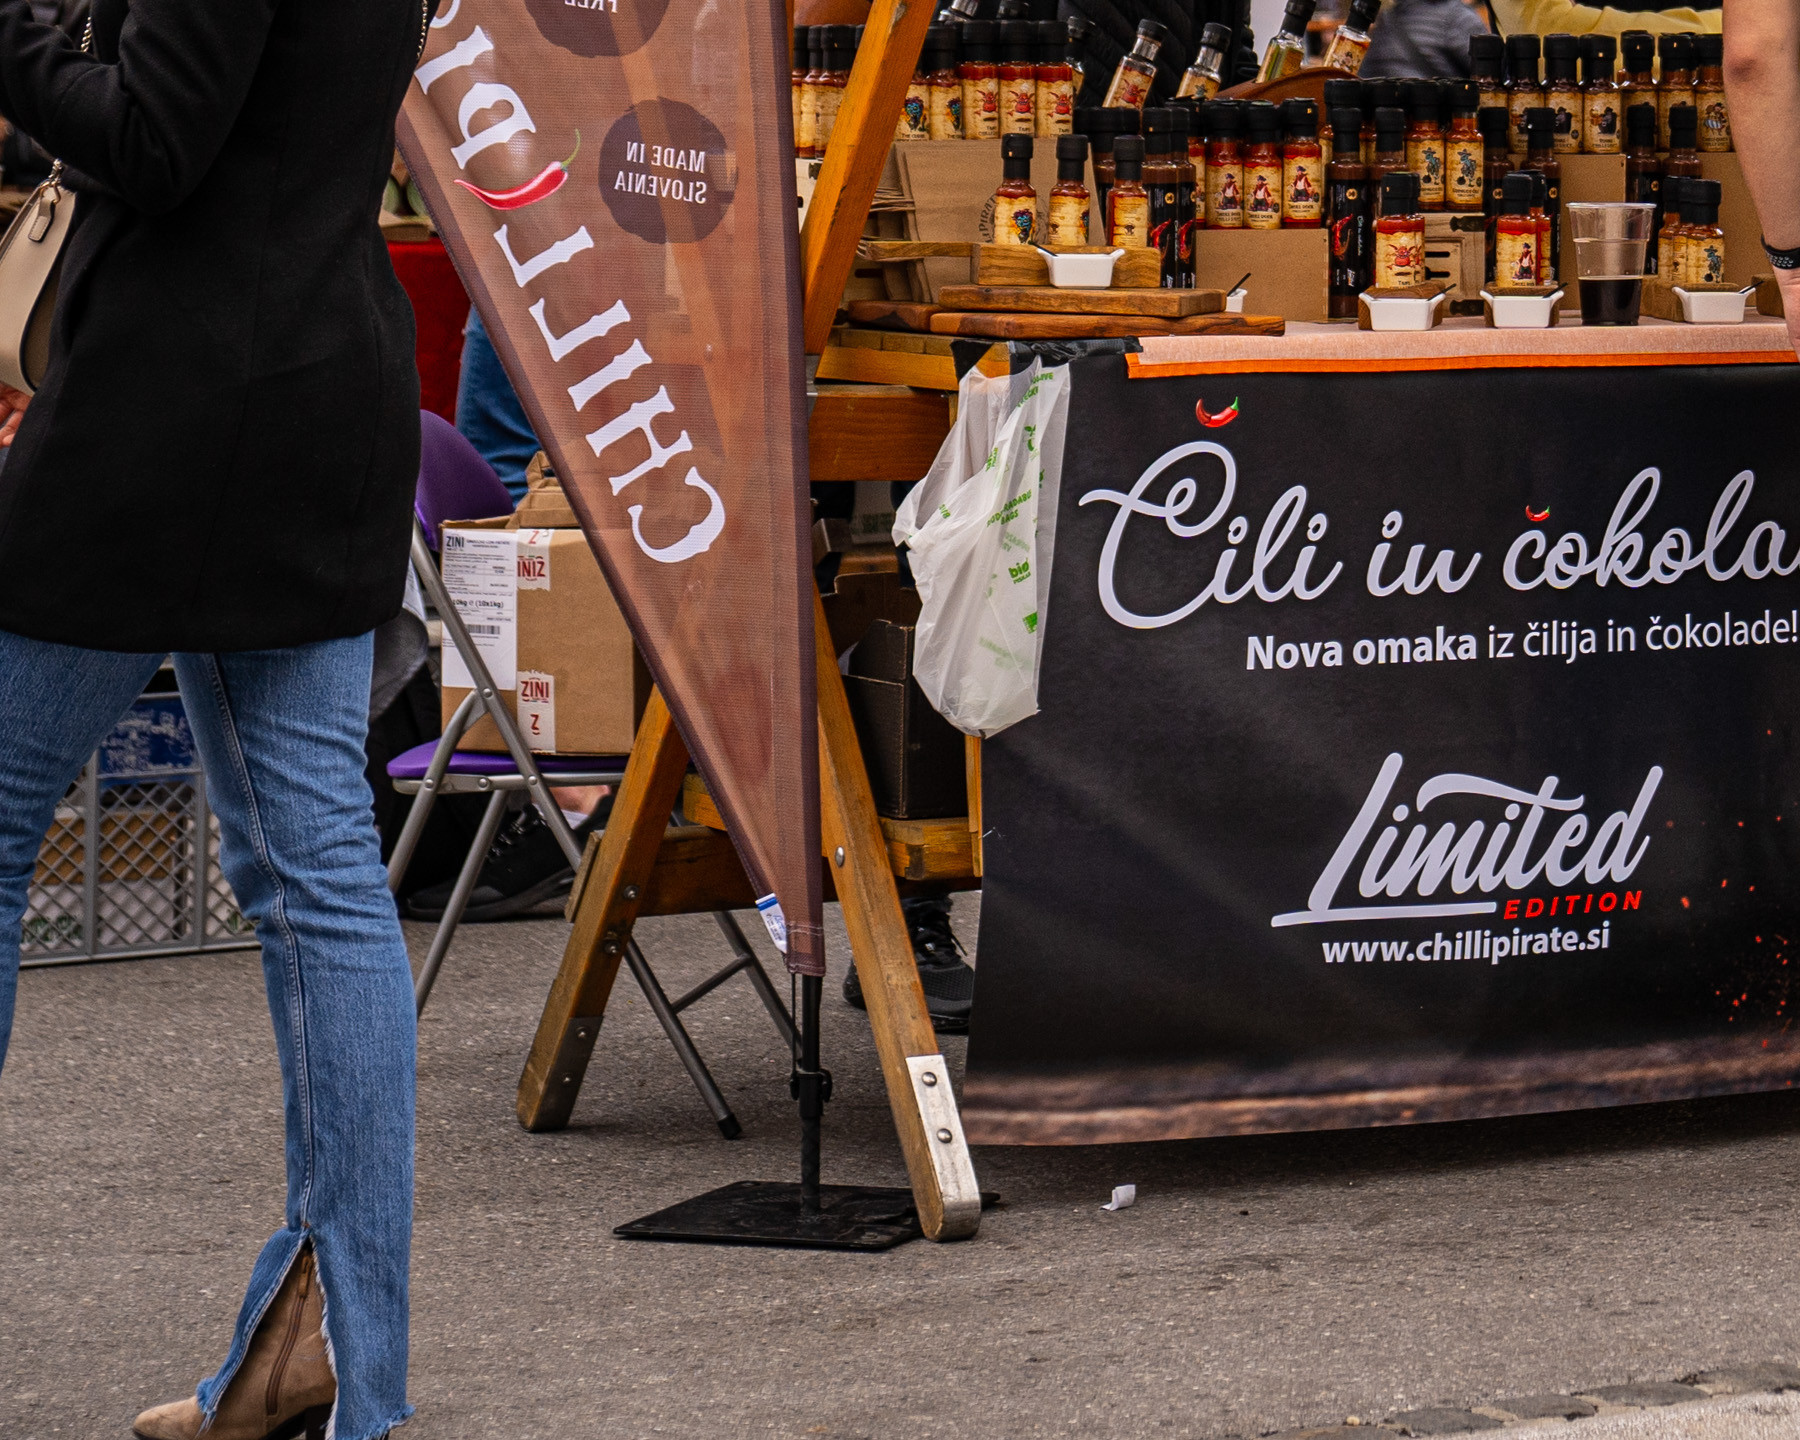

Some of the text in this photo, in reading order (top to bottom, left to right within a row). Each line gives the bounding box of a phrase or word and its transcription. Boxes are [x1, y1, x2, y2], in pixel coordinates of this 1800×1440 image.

[1078, 395, 1345, 630] Čili
[1367, 510, 1482, 597] in
[446, 535, 465, 548] ZINI
[1245, 611, 1800, 671] Nova omaka iz čilija in čokolade!
[520, 680, 549, 698] ZINI
[530, 713, 540, 731] Z
[1272, 752, 1663, 927] Limited
[1503, 890, 1642, 920] EDITION
[1322, 921, 1610, 965] www.chillipirate.si
